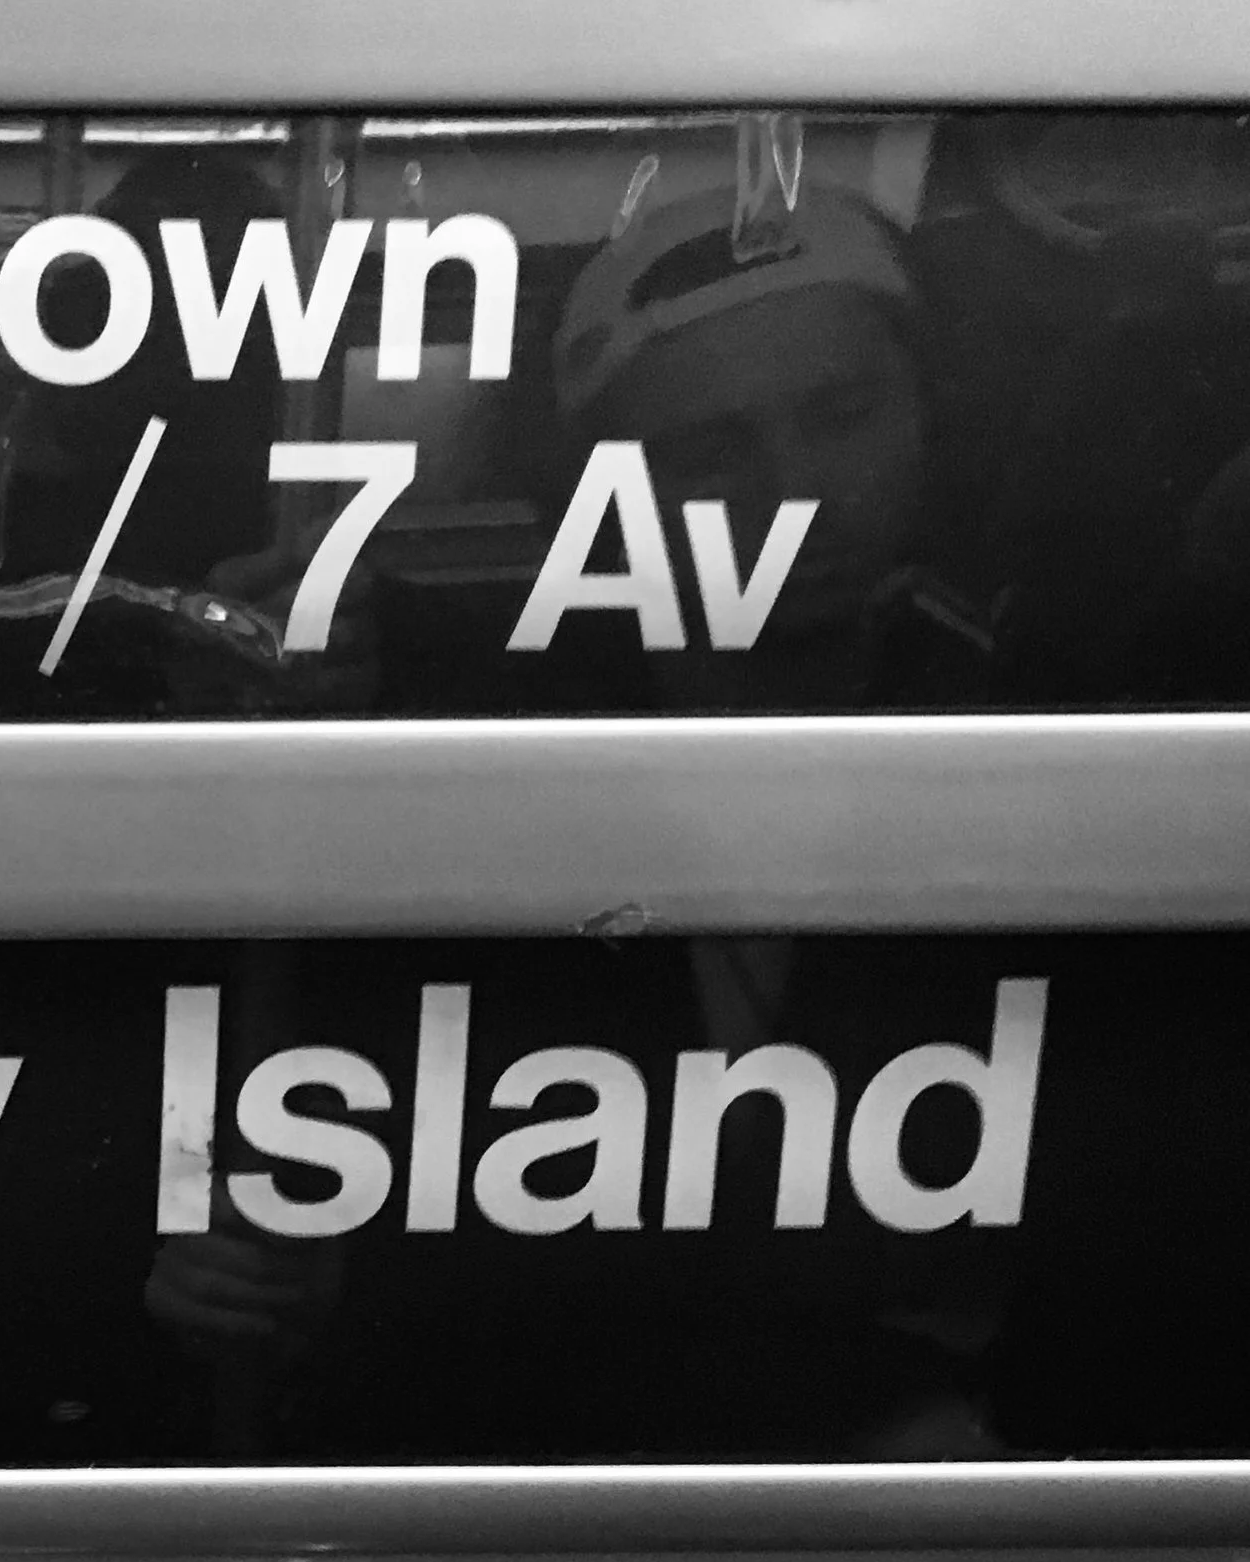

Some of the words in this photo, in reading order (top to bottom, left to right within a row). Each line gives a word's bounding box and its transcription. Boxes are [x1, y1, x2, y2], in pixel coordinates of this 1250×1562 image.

[38, 416, 168, 675] /
[267, 440, 418, 652] 7
[506, 439, 821, 652] Av
[156, 976, 1050, 1238] Island
